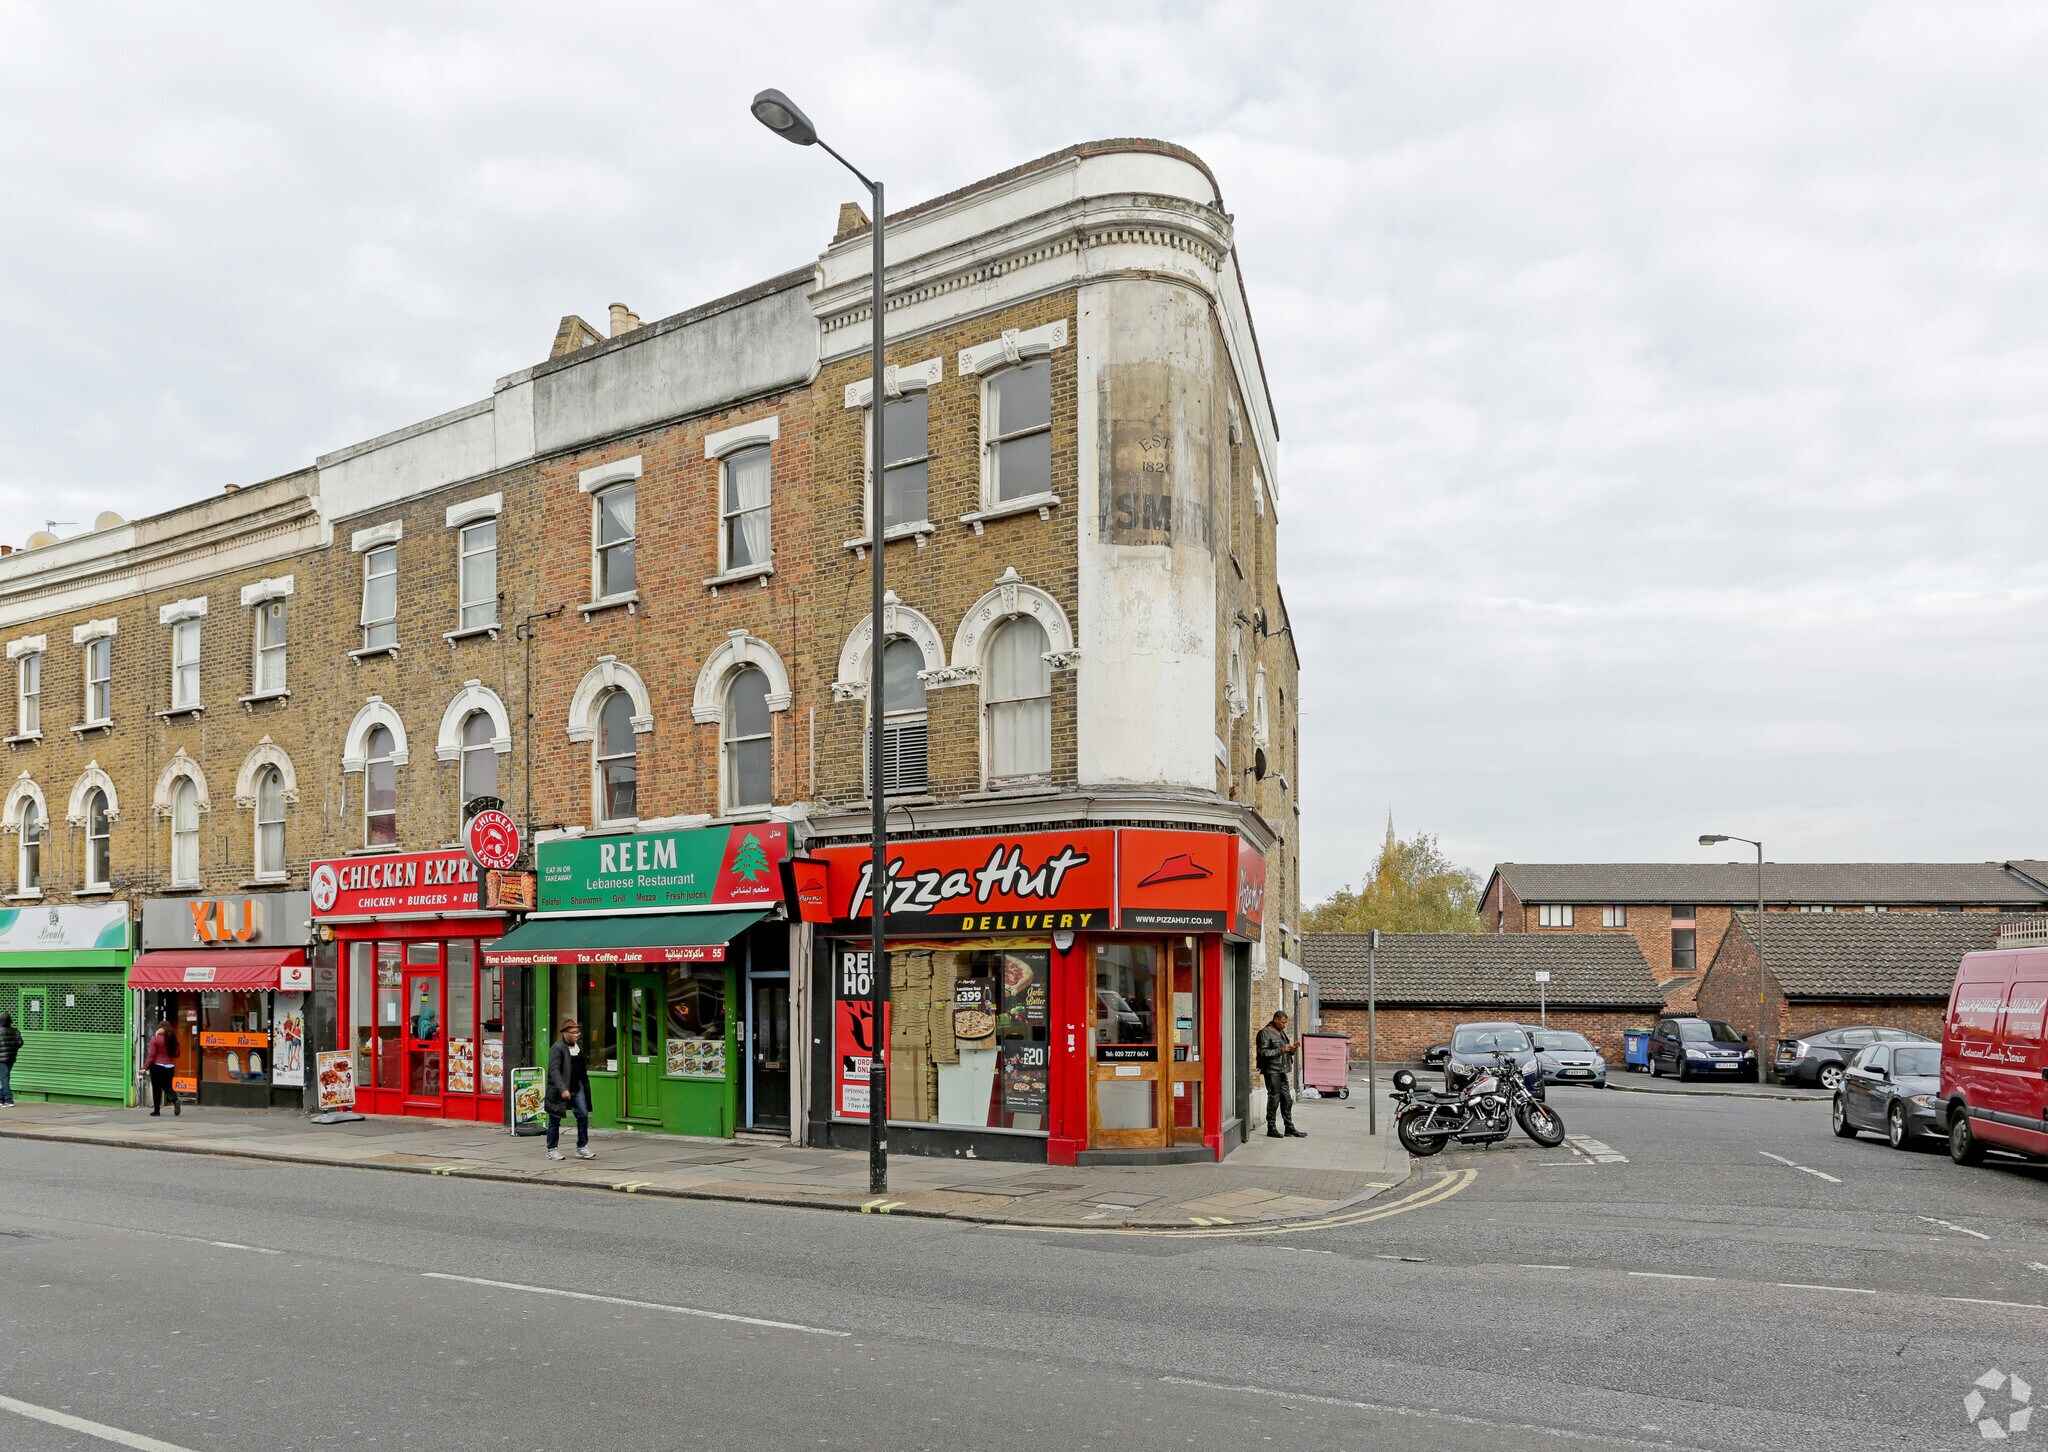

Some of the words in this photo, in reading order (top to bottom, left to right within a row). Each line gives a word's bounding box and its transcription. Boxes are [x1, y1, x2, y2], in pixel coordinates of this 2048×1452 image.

[474, 813, 514, 833] CHICKEN
[476, 849, 515, 869] EXPRESS
[600, 838, 678, 873] REEM
[339, 862, 418, 891] CHICKEN
[545, 874, 572, 882] TAKEAWAY
[586, 878, 634, 890] Lebanese
[638, 873, 695, 887] Restaurant
[850, 860, 971, 920] Pizza
[976, 847, 1087, 902] Hut
[358, 897, 396, 908] CHICKEN
[407, 894, 448, 906] BURGERS
[462, 892, 478, 903] RIB
[542, 898, 562, 906] Falafel
[570, 896, 602, 905] Shawarma
[612, 894, 626, 902] Grill
[636, 893, 656, 902] Mezza
[666, 892, 685, 900] Fresh
[686, 891, 708, 901] juices
[189, 900, 253, 942] XLJ
[962, 914, 1092, 931] DELIVERY
[1135, 916, 1213, 925] WWW.PIZZAHUT.CO.UK
[37, 925, 66, 943] Beauty
[486, 956, 500, 964] Fine
[500, 956, 532, 964] Lebanese
[532, 955, 558, 964] Cuisine
[577, 954, 590, 962] Tea
[594, 954, 617, 962] Coffee
[623, 952, 642, 962] Juice
[712, 948, 722, 958] 55
[844, 952, 874, 974] RE
[844, 974, 874, 995] HO
[1958, 998, 2000, 1013] SAPPHIRE
[206, 1035, 217, 1044] Ria
[238, 1036, 250, 1045] Ria
[1024, 1048, 1044, 1066] £20
